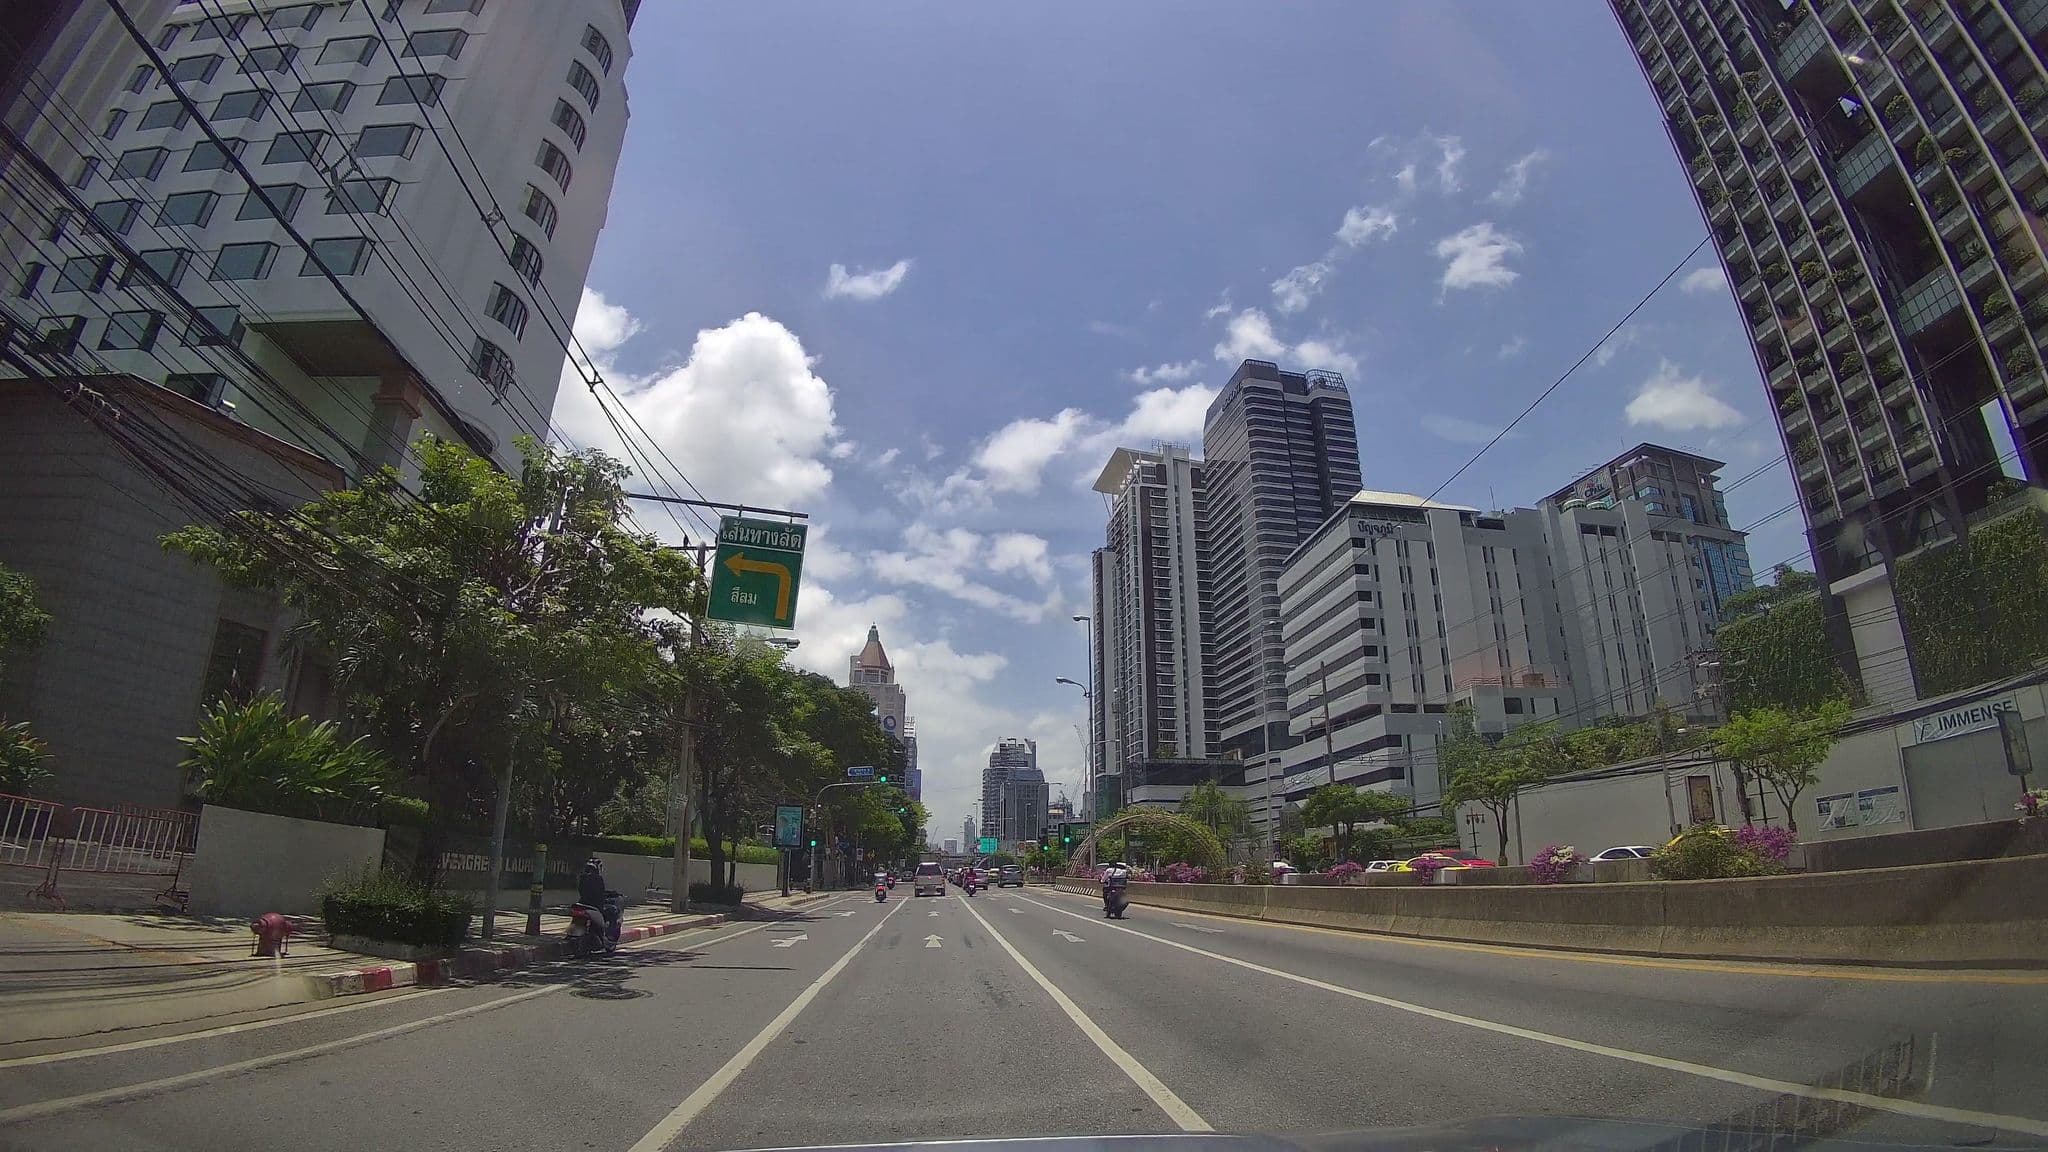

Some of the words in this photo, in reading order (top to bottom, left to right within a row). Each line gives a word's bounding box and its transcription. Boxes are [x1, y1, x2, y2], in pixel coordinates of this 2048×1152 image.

[722, 521, 802, 549] เส้นทางลัด
[730, 586, 757, 605] สีลม
[1938, 700, 2012, 731] IMMENSE
